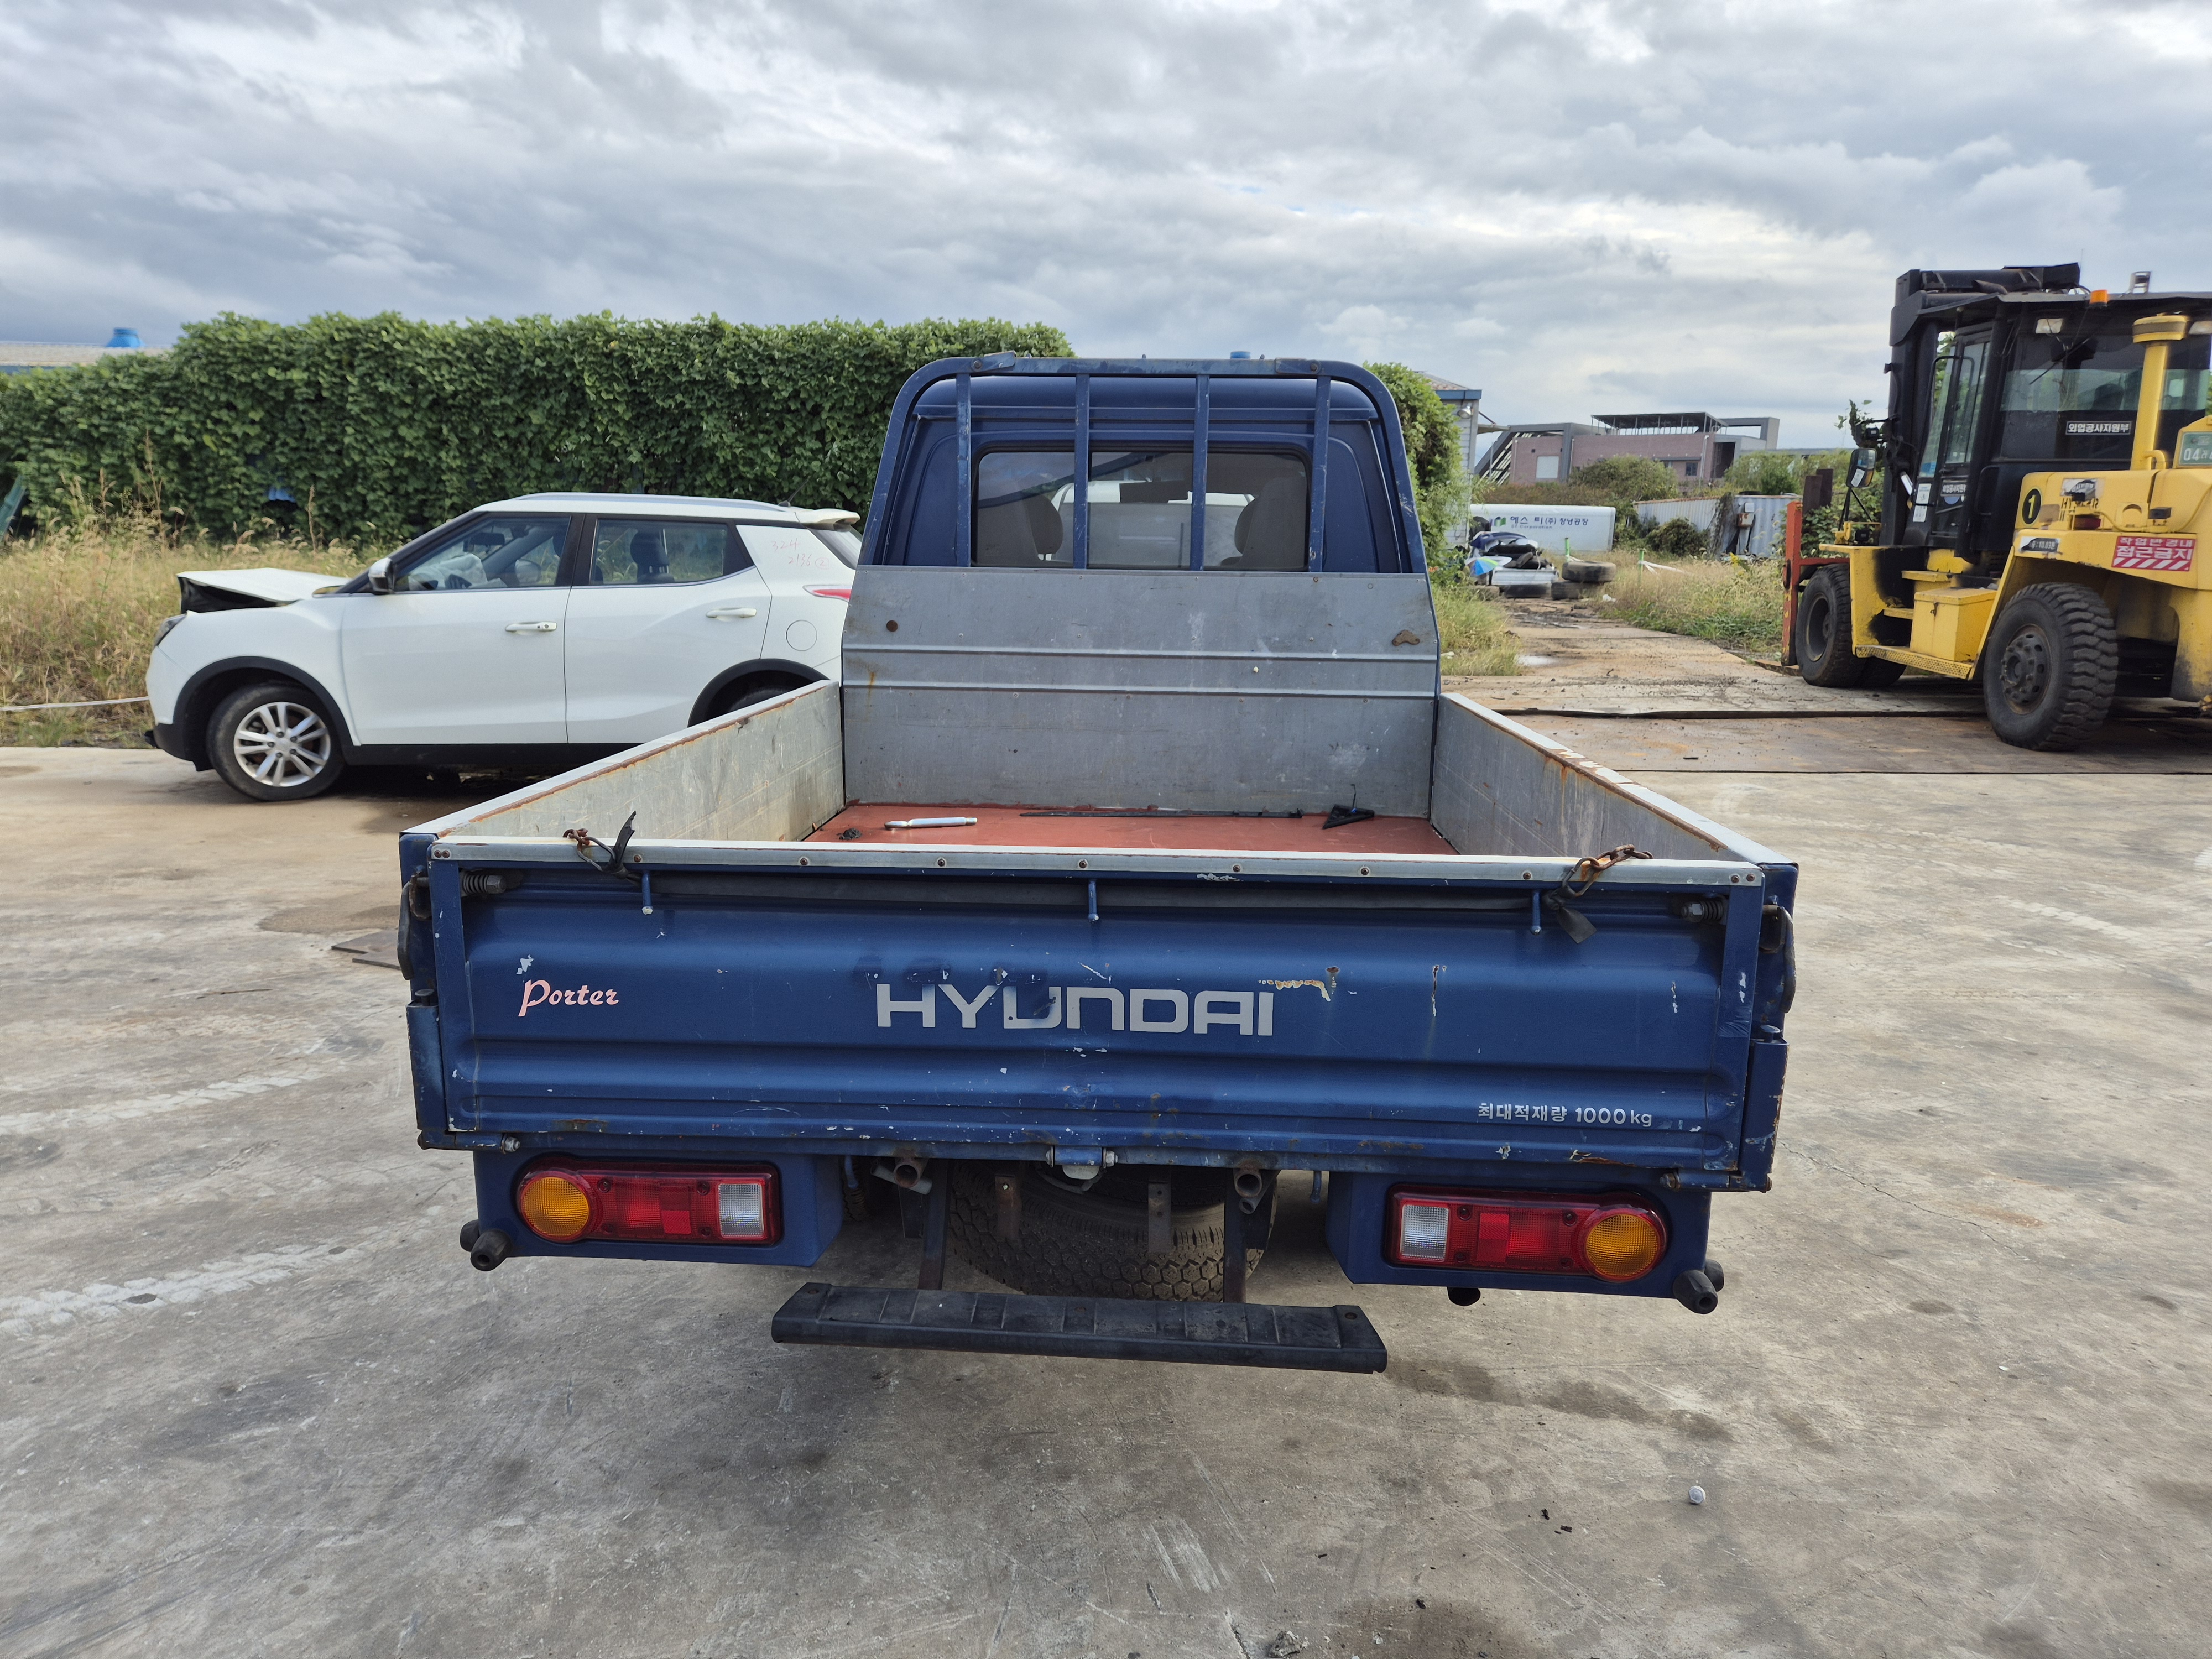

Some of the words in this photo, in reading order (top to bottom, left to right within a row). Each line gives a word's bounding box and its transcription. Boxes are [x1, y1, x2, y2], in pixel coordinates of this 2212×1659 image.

[2068, 423, 2129, 433] 외업공사지원부
[2028, 494, 2036, 519] 1
[787, 553, 812, 567] 2136
[2116, 546, 2193, 560] 접근금지
[518, 979, 619, 1017] Porter
[876, 983, 1274, 1036] HYUNDAI
[1478, 1103, 1567, 1123] 최대적재량
[1575, 1107, 1626, 1125] 1000
[1630, 1109, 1653, 1128] kg
